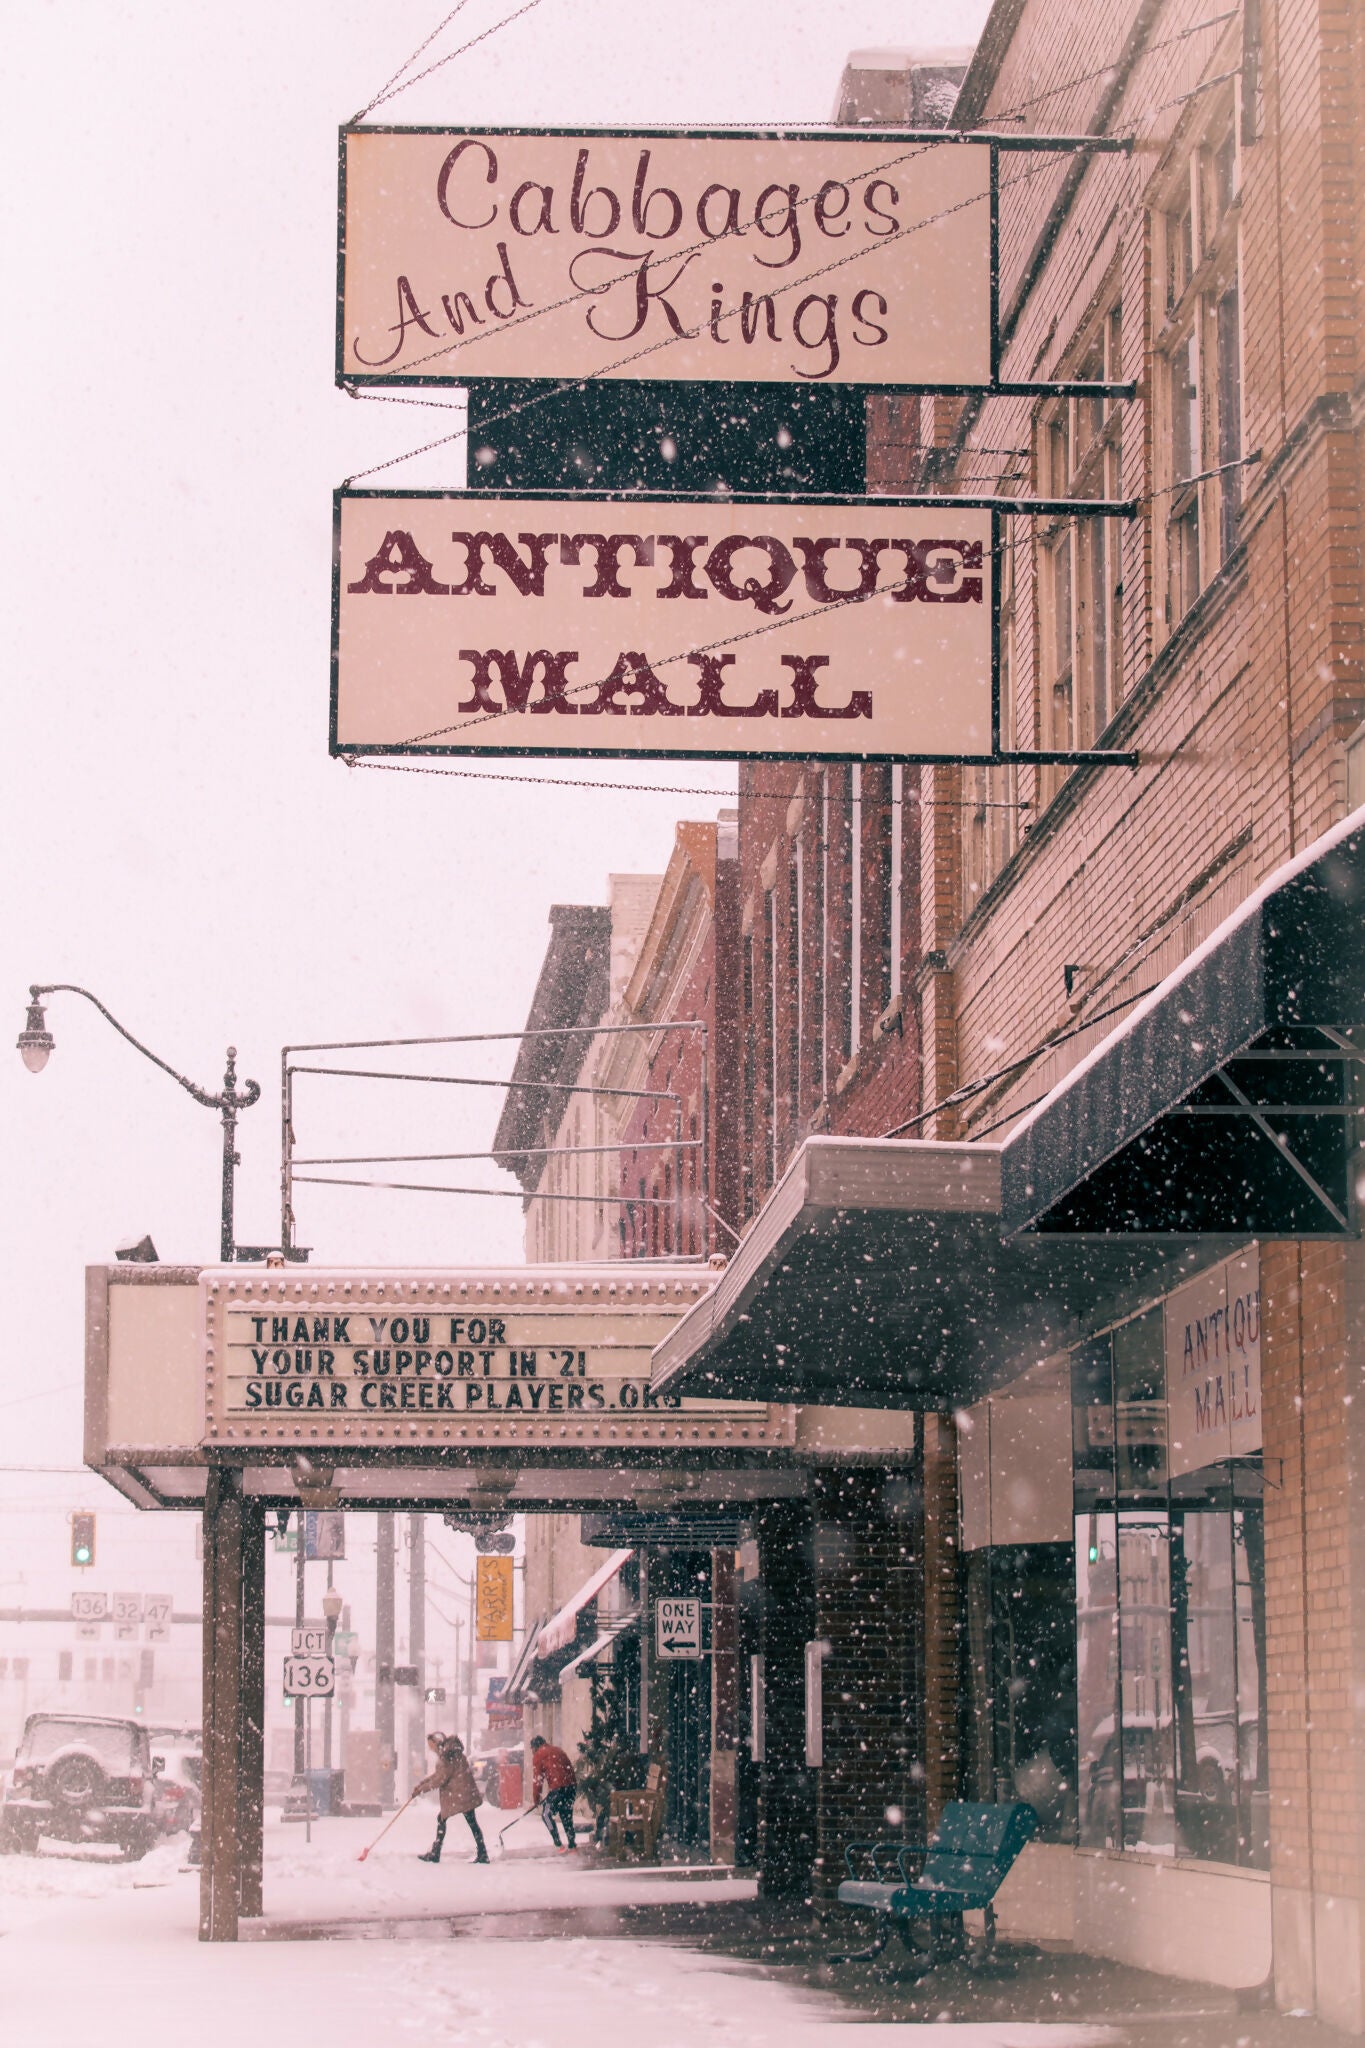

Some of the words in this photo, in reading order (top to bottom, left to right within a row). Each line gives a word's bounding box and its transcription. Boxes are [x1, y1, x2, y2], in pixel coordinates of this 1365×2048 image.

[436, 139, 900, 268] Cabbages
[353, 242, 533, 366] And
[569, 247, 889, 379] Kings
[347, 530, 983, 615] ANTIQUE
[458, 648, 873, 719] MALL
[251, 1317, 350, 1343] THANK
[369, 1317, 430, 1344] YOU
[450, 1318, 507, 1344] FOR
[251, 1349, 335, 1375] YOUR
[353, 1350, 495, 1376] SUPPORT
[510, 1351, 536, 1377] IN
[245, 1382, 348, 1408] SUGAR
[360, 1382, 454, 1408] CREEK
[1195, 1364, 1257, 1434] MALL
[76, 1599, 103, 1615] 136
[117, 1602, 138, 1618] 32
[148, 1604, 169, 1619] 47
[662, 1603, 695, 1617] ONE
[661, 1620, 695, 1634] WAY
[294, 1632, 324, 1649] JCT
[289, 1665, 330, 1687] 136
